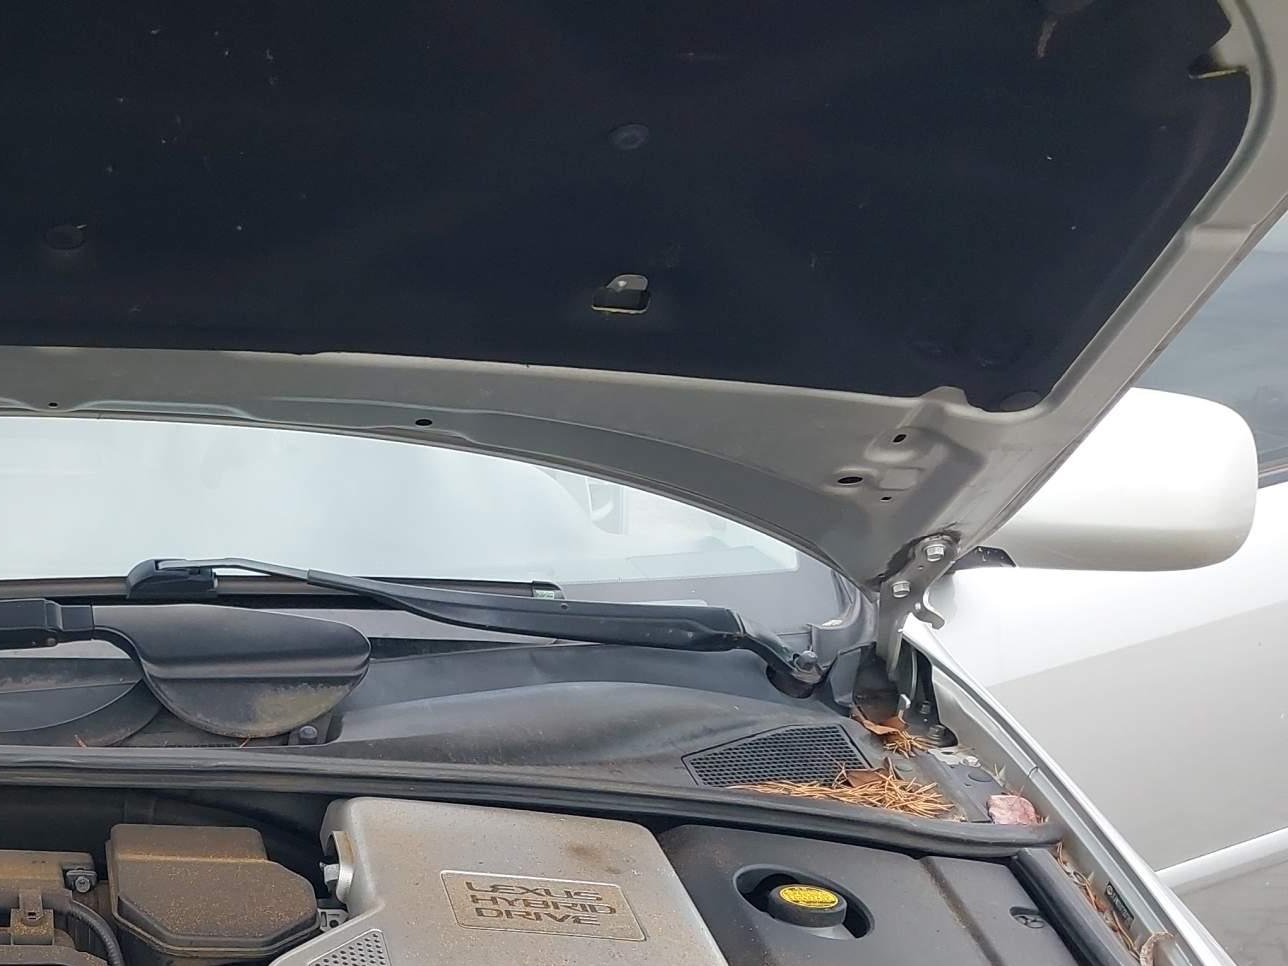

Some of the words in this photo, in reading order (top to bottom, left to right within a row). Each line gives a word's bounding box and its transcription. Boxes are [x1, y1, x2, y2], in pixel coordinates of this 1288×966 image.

[465, 881, 603, 901] LEXUS
[470, 894, 617, 915] HYBRID
[474, 907, 601, 926] DRIVE
